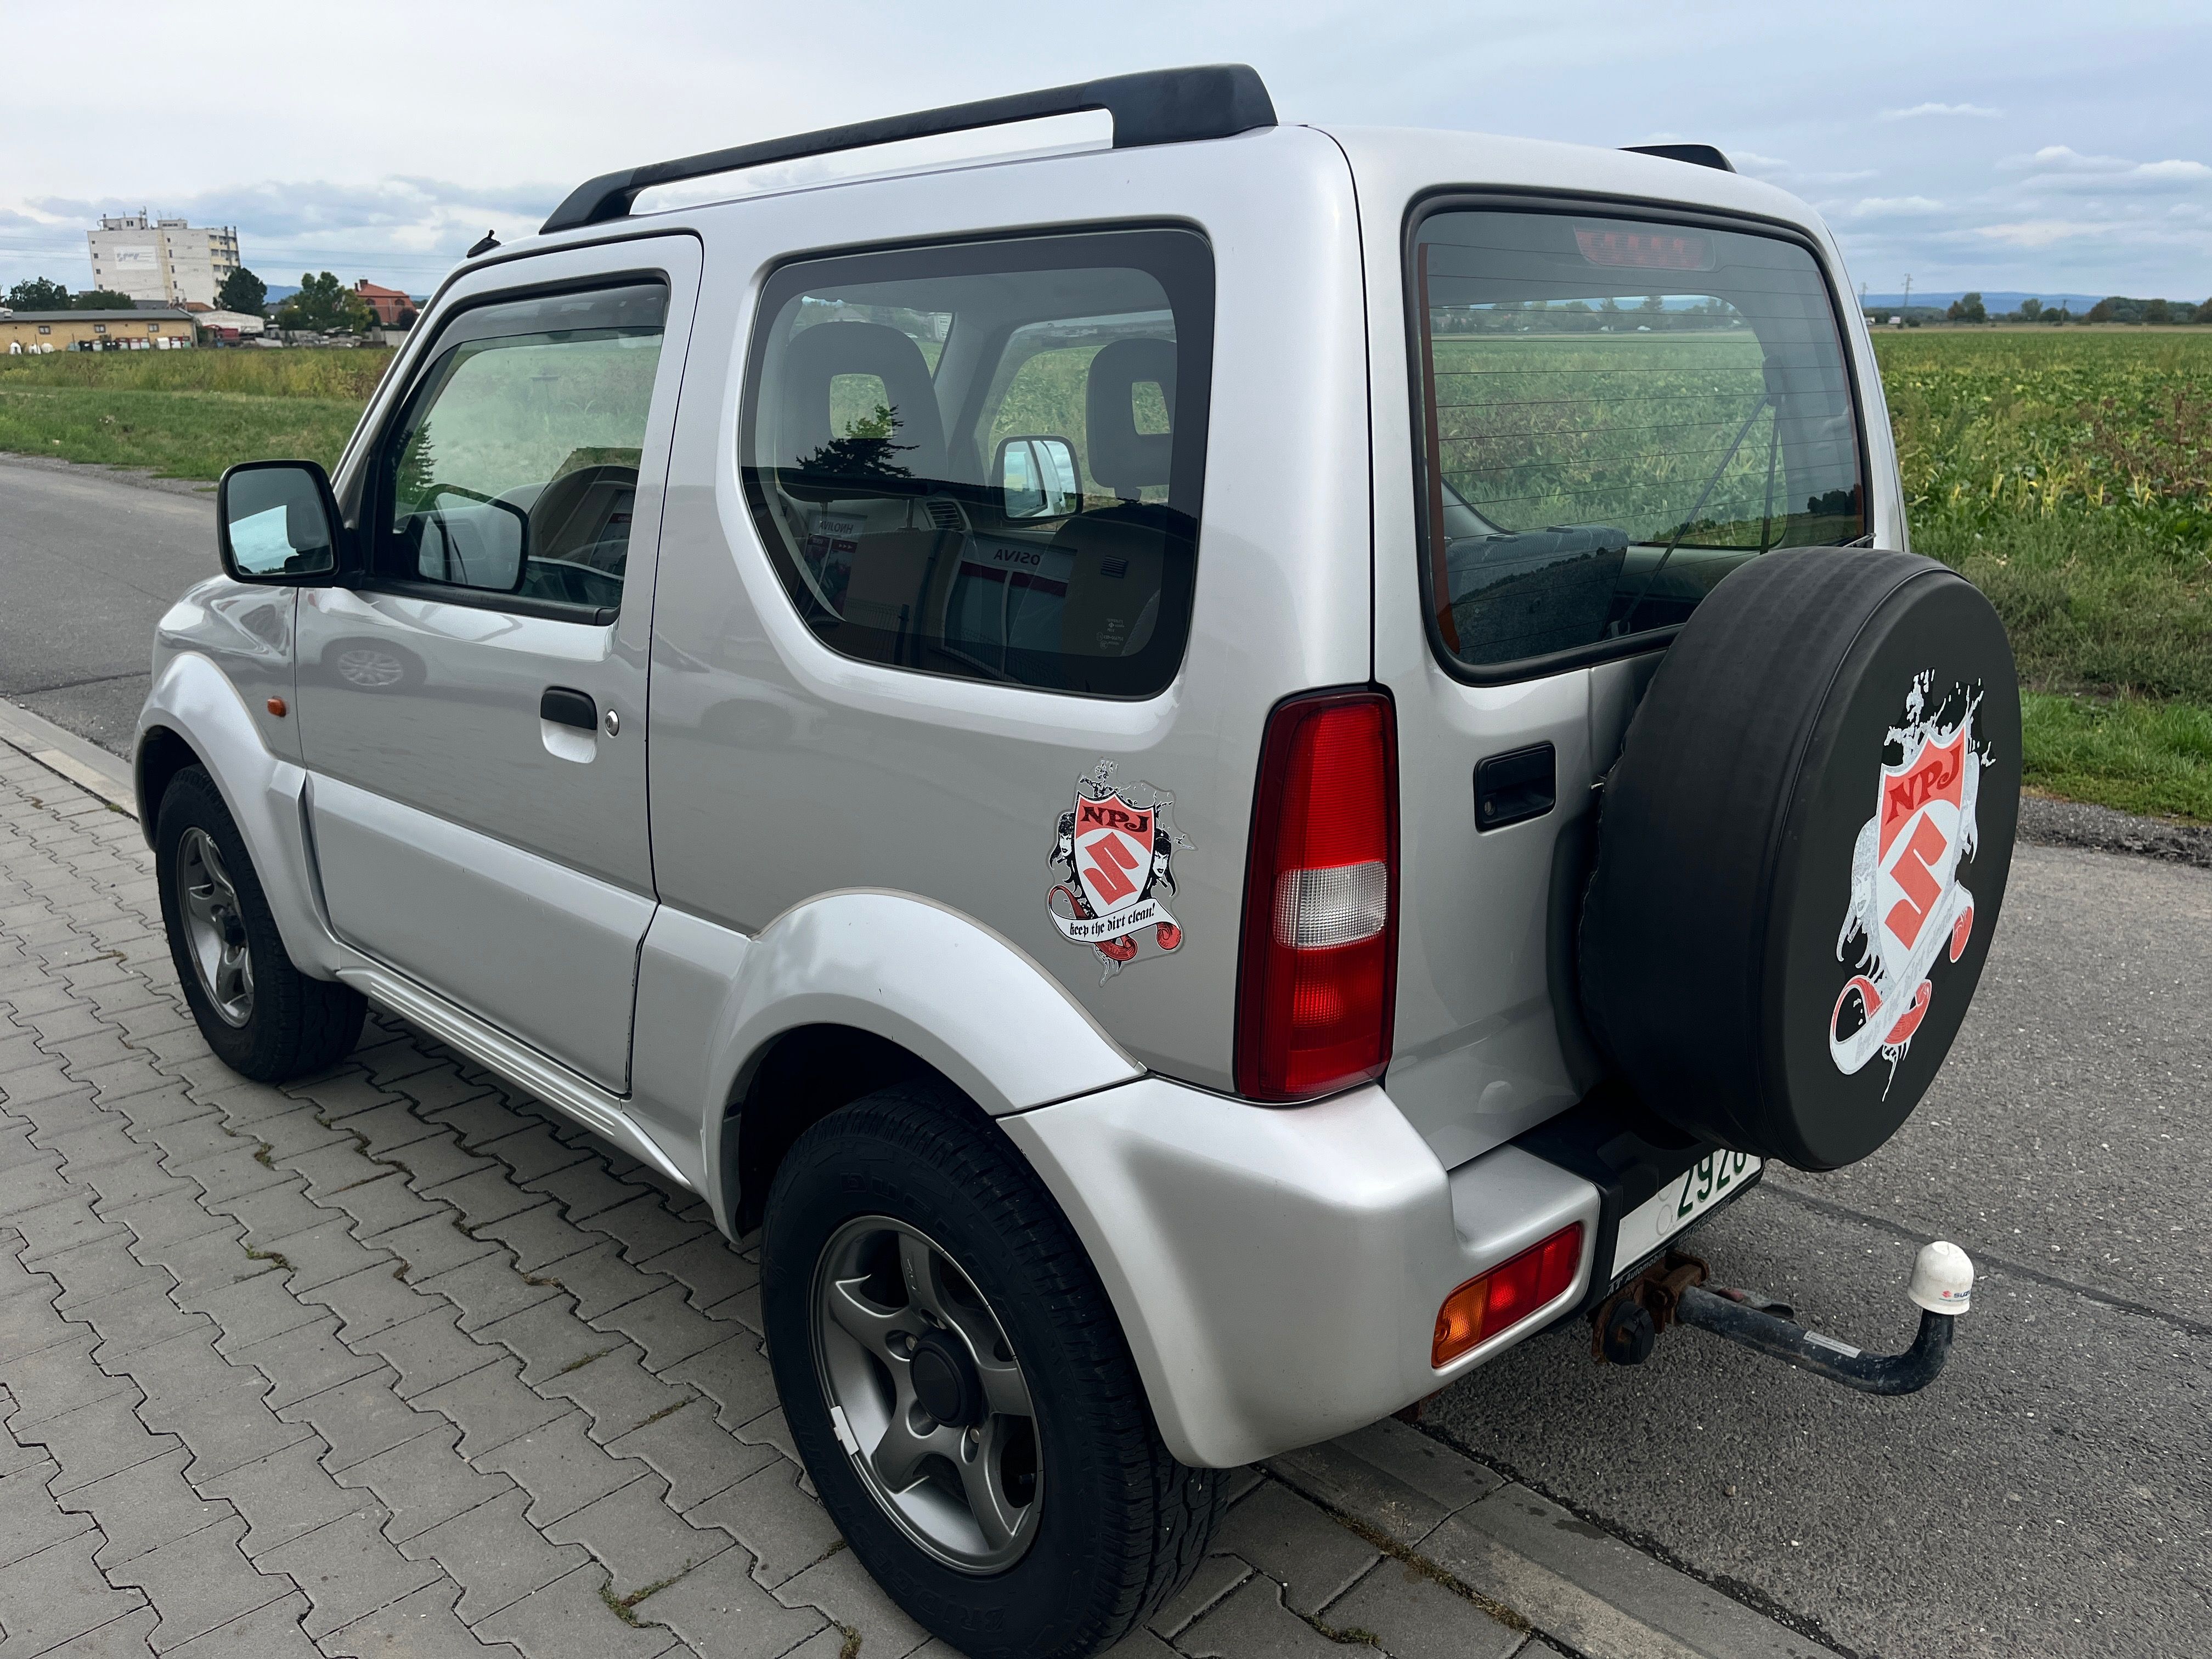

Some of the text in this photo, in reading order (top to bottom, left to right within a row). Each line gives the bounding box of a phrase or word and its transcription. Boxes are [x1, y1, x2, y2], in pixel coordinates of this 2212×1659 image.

[1886, 742, 1961, 826] NPJ
[1080, 805, 1150, 833] NPJ
[1070, 902, 1155, 938] keep the dirt clean!
[1624, 1249, 1667, 1284] Automobile
